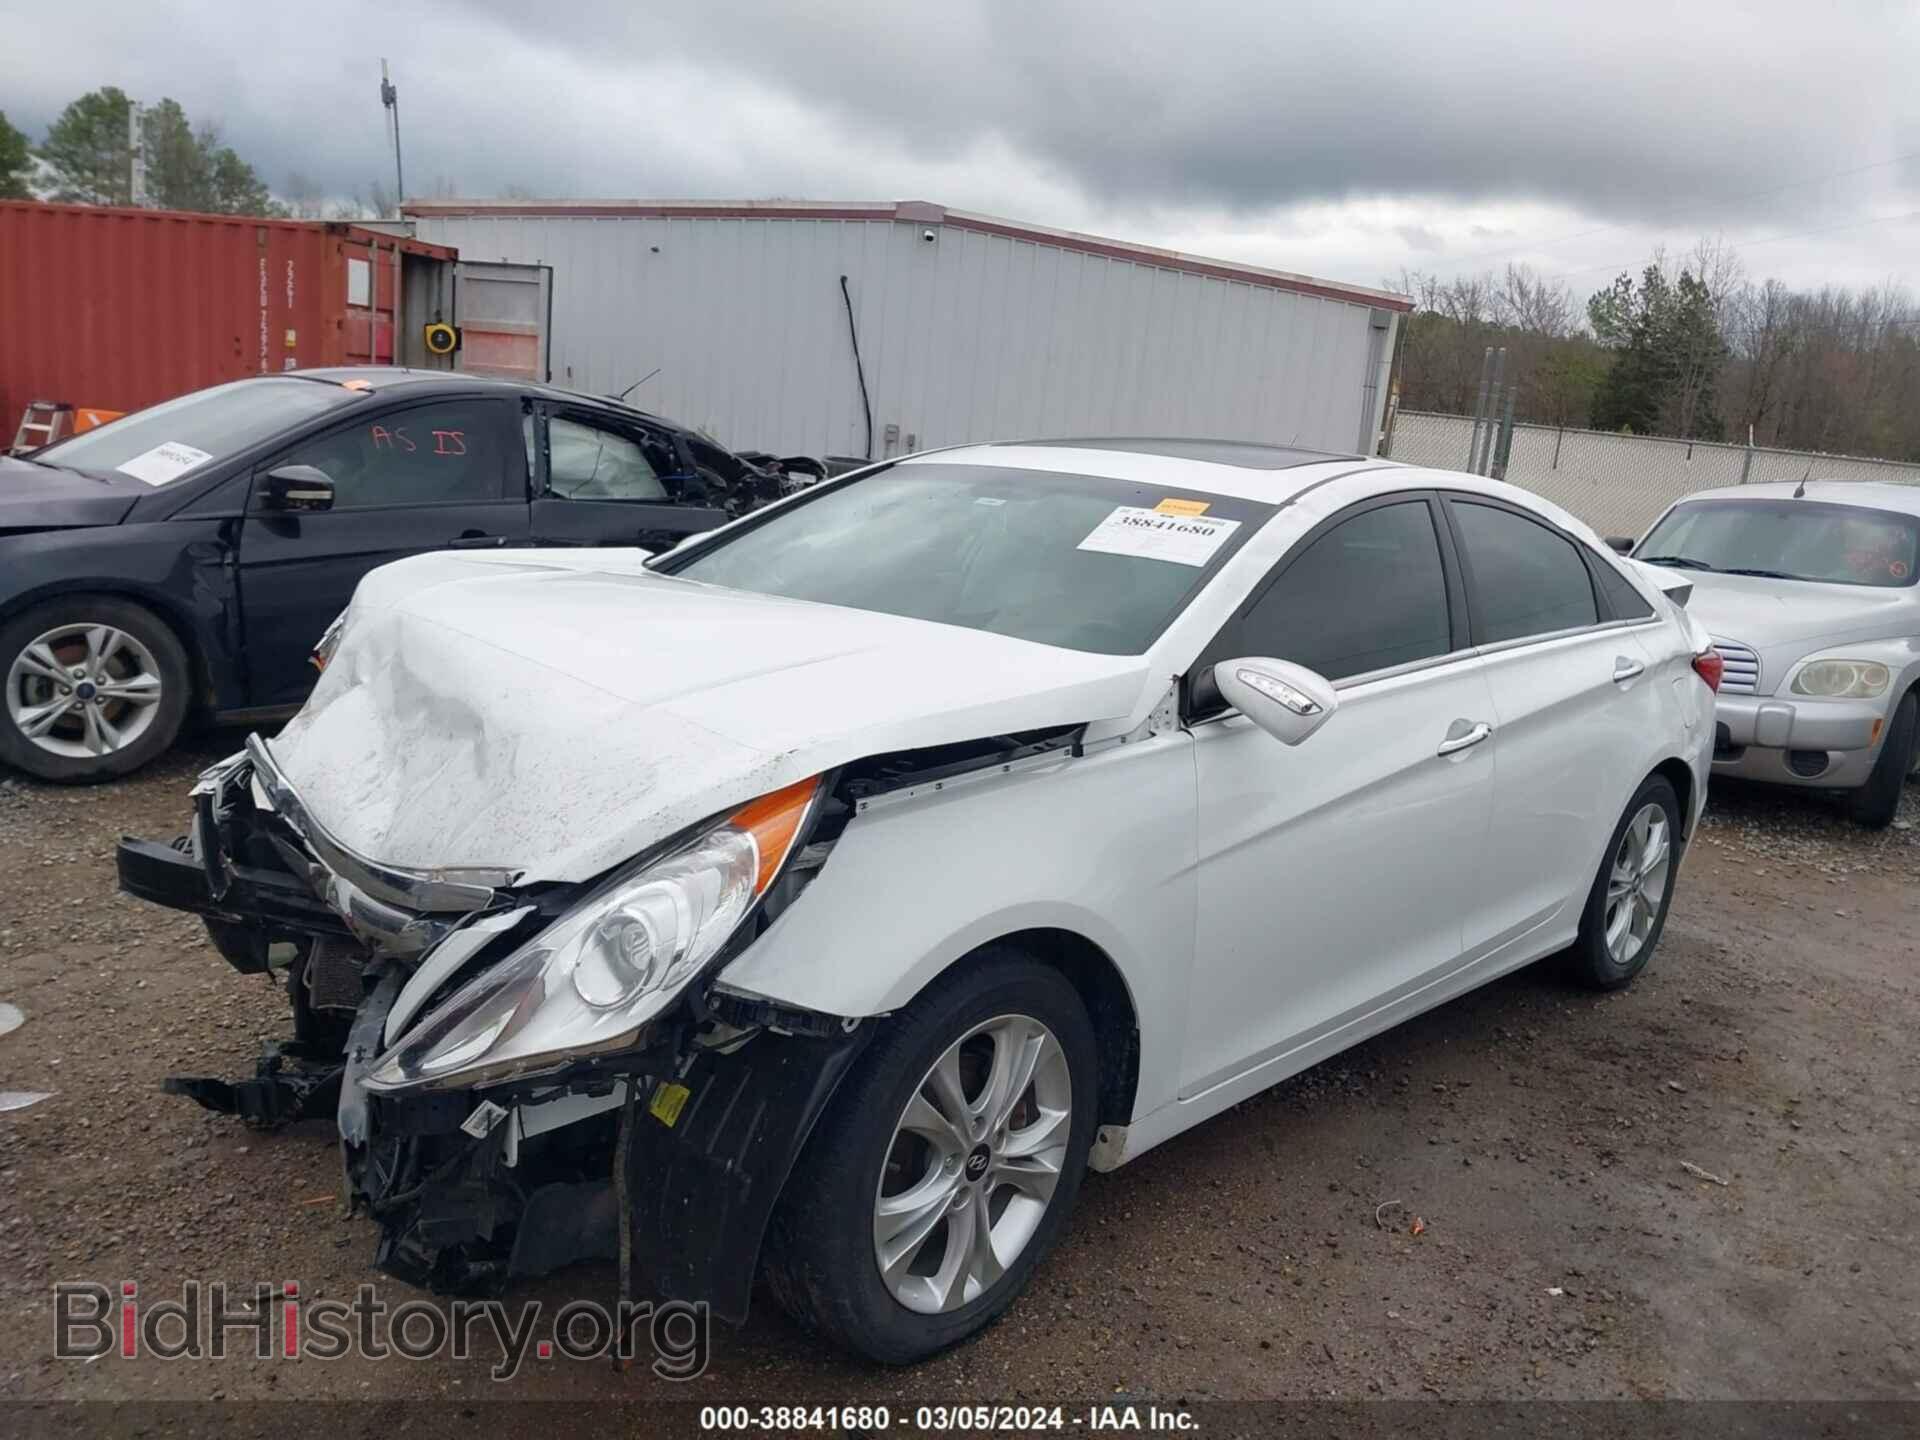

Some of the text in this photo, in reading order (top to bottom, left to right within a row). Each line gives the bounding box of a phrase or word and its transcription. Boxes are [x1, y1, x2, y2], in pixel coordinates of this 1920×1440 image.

[371, 425, 466, 455] AS IS
[1121, 515, 1216, 537] 38841680
